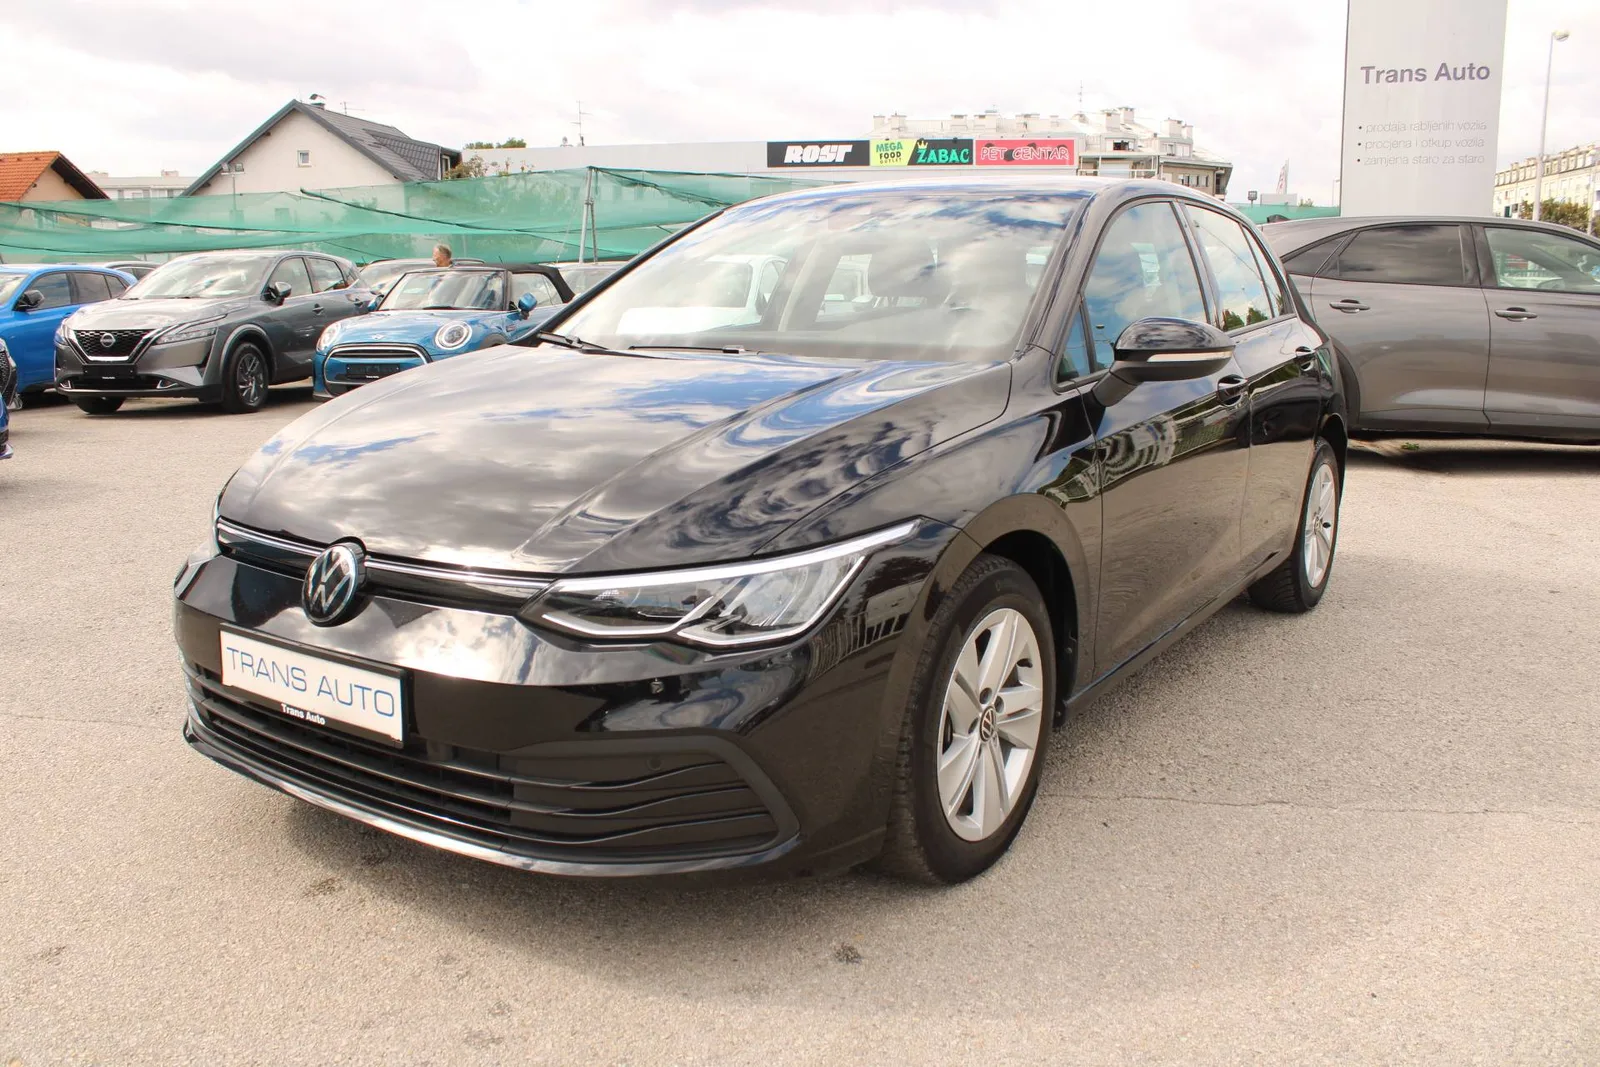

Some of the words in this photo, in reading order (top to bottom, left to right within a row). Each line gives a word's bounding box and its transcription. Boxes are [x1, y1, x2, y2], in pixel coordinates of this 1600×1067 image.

[1360, 66, 1428, 84] Trans
[1434, 62, 1490, 81] Auto
[1365, 122, 1406, 134] prodaja
[1409, 120, 1454, 132] rabljenih
[1457, 120, 1487, 131] vozila
[876, 142, 903, 152] MEGA
[1364, 138, 1412, 150] procjena
[1420, 138, 1452, 149] otkup
[1455, 136, 1485, 148] vozila
[784, 144, 853, 164] ROST
[981, 147, 1007, 160] PET
[1012, 146, 1069, 160] CENTAR
[1363, 155, 1409, 167] zamjena
[1412, 154, 1440, 165] staro
[1442, 155, 1455, 165] za
[1457, 153, 1485, 165] staro
[226, 646, 308, 692] TRANS
[317, 675, 396, 718] AUTO
[280, 703, 305, 720] Trans
[306, 710, 326, 726] Auto
